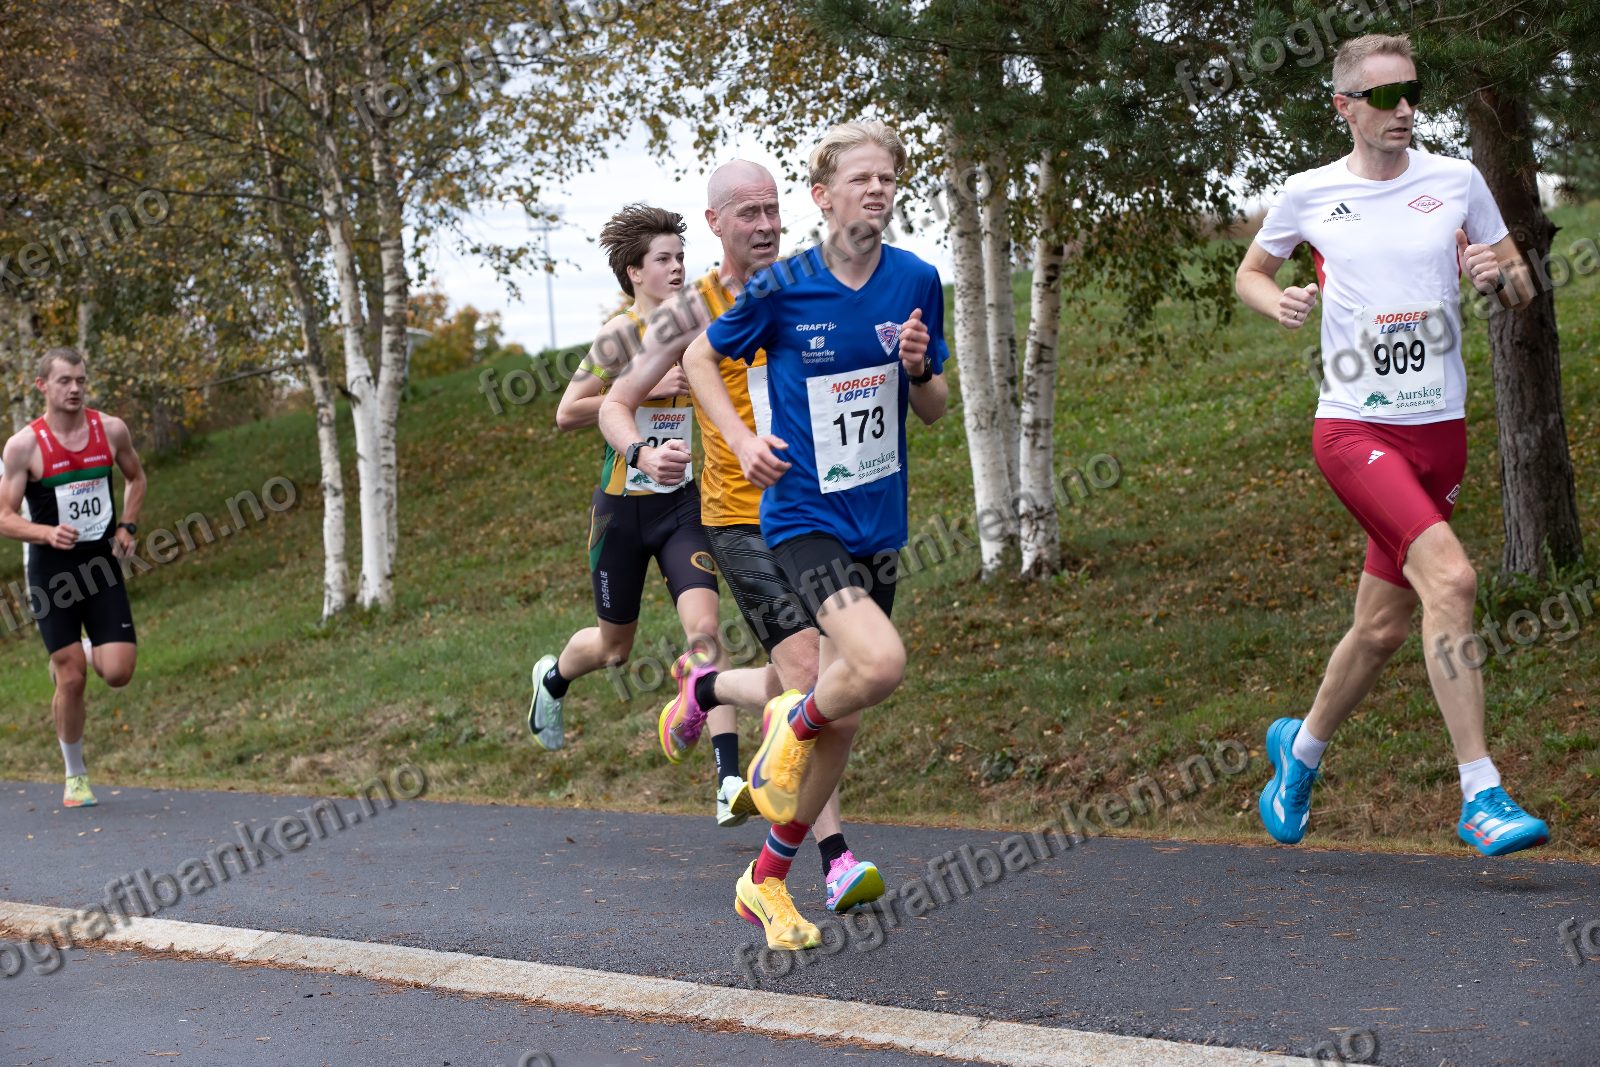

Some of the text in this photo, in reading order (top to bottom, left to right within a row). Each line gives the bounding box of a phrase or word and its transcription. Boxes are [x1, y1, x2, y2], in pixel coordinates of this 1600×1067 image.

[1374, 311, 1428, 324] NORGES
[796, 323, 828, 331] CRAFT
[1380, 322, 1419, 334] LØPET
[801, 350, 835, 358] Romerike
[1373, 339, 1425, 376] 909
[831, 374, 887, 394] NORGES
[836, 386, 879, 404] LØPET
[1396, 387, 1442, 400] Aurskog
[650, 413, 686, 422] NORGES
[653, 422, 680, 430] LØPET
[833, 405, 885, 446] 173
[858, 450, 896, 471] Aurskog
[69, 480, 101, 490] NORGES
[69, 497, 101, 520] 340
